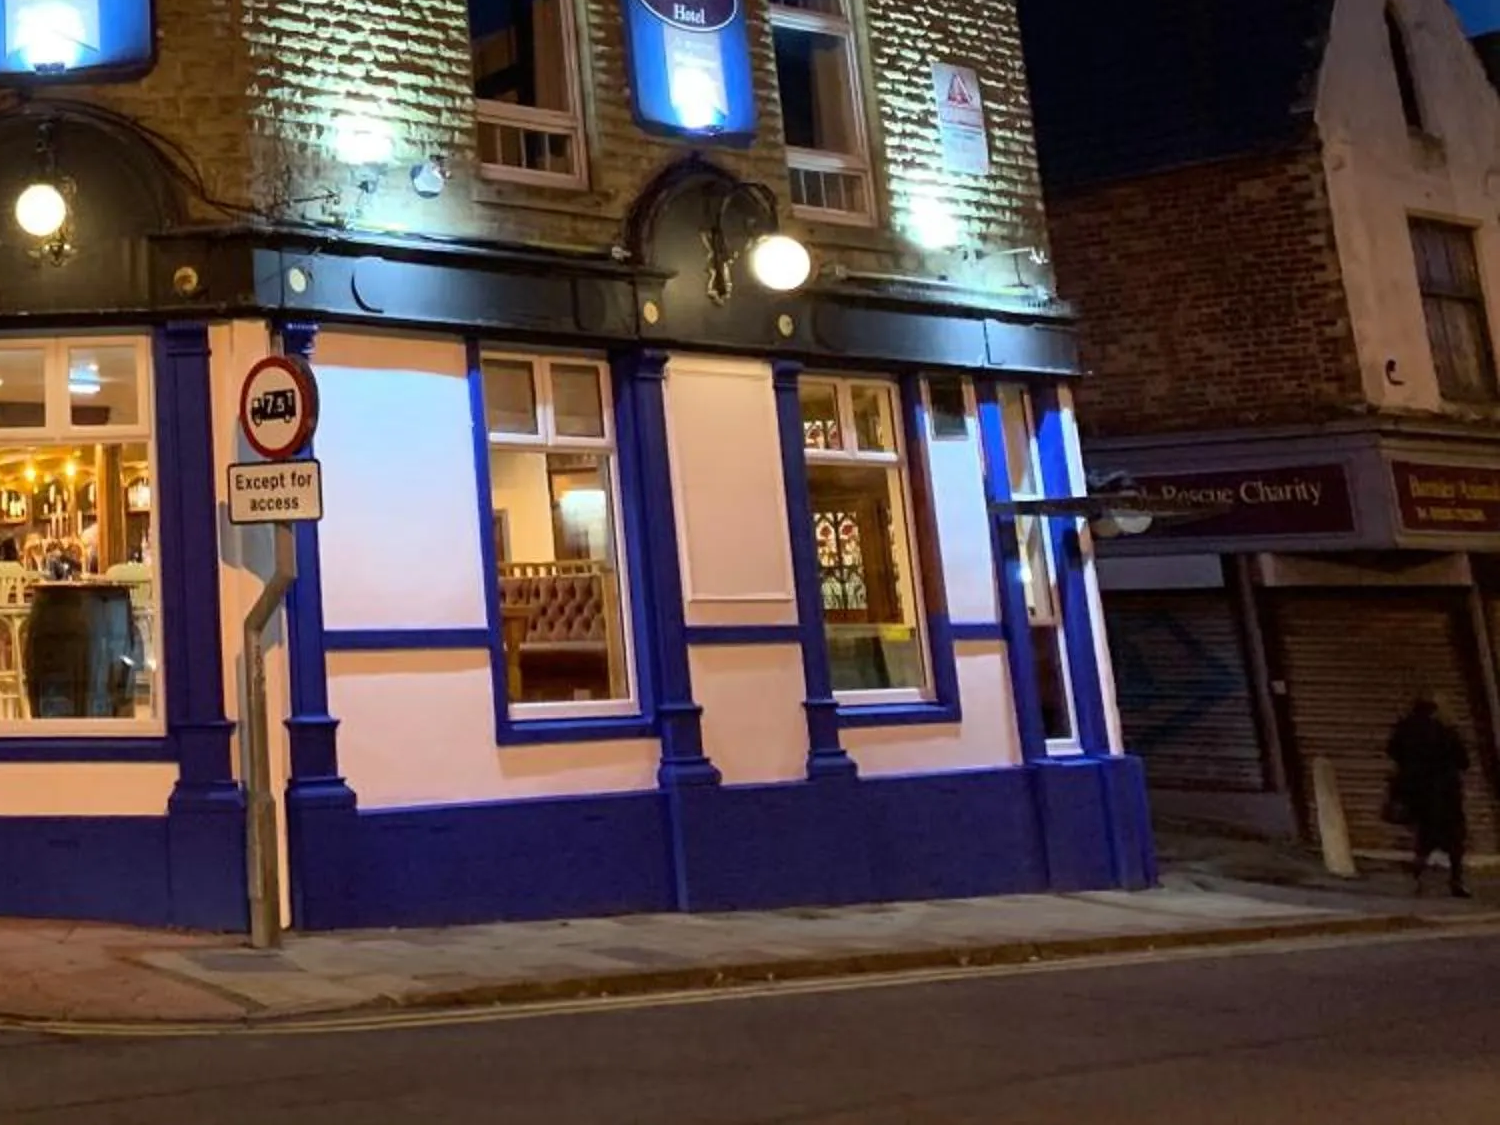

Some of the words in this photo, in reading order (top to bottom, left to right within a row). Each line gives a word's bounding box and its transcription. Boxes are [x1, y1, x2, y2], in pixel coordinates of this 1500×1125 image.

[672, 3, 706, 25] Hotel
[235, 474, 285, 491] Except
[291, 472, 313, 488] for
[1239, 476, 1322, 505] Charity
[250, 496, 299, 512] access
